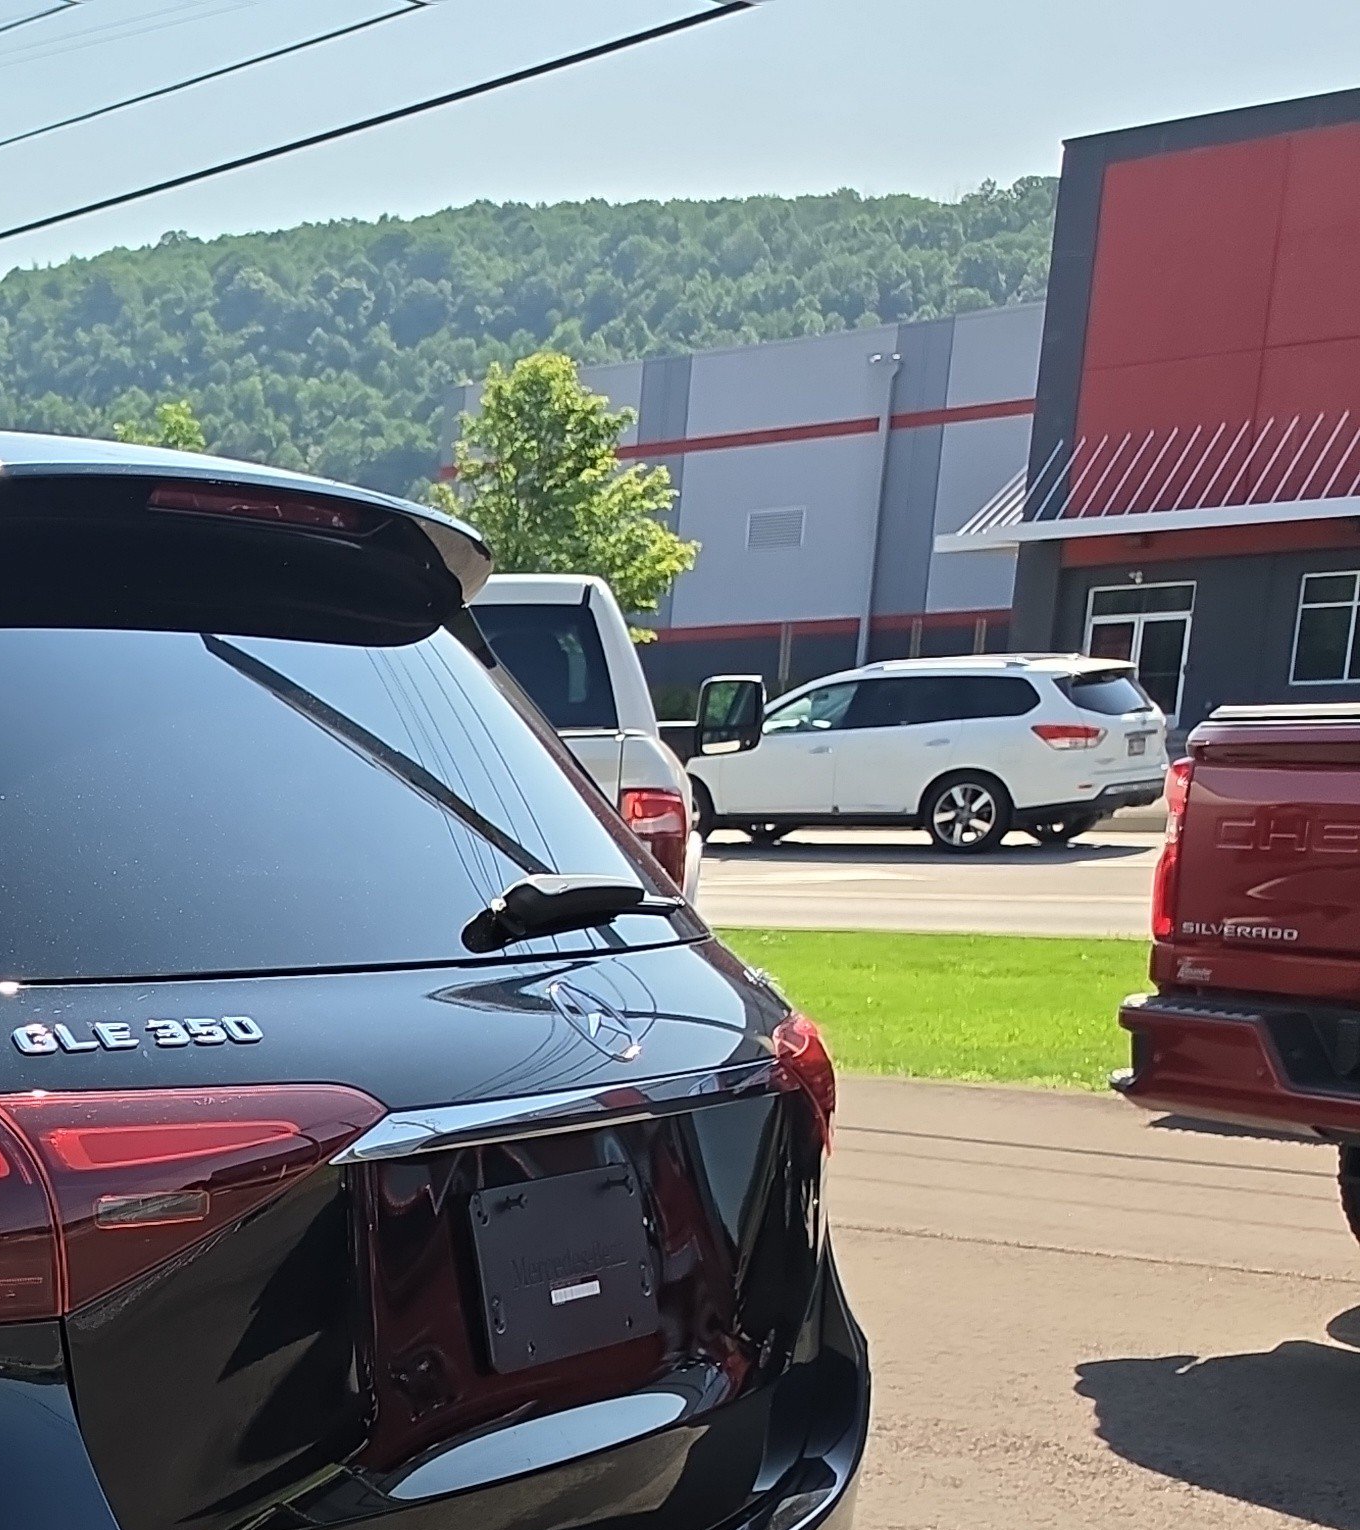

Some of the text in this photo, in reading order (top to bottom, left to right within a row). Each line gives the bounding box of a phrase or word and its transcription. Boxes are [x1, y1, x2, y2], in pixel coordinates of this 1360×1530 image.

[1181, 921, 1299, 941] SILVERADO
[11, 1014, 265, 1056] GLE 350
